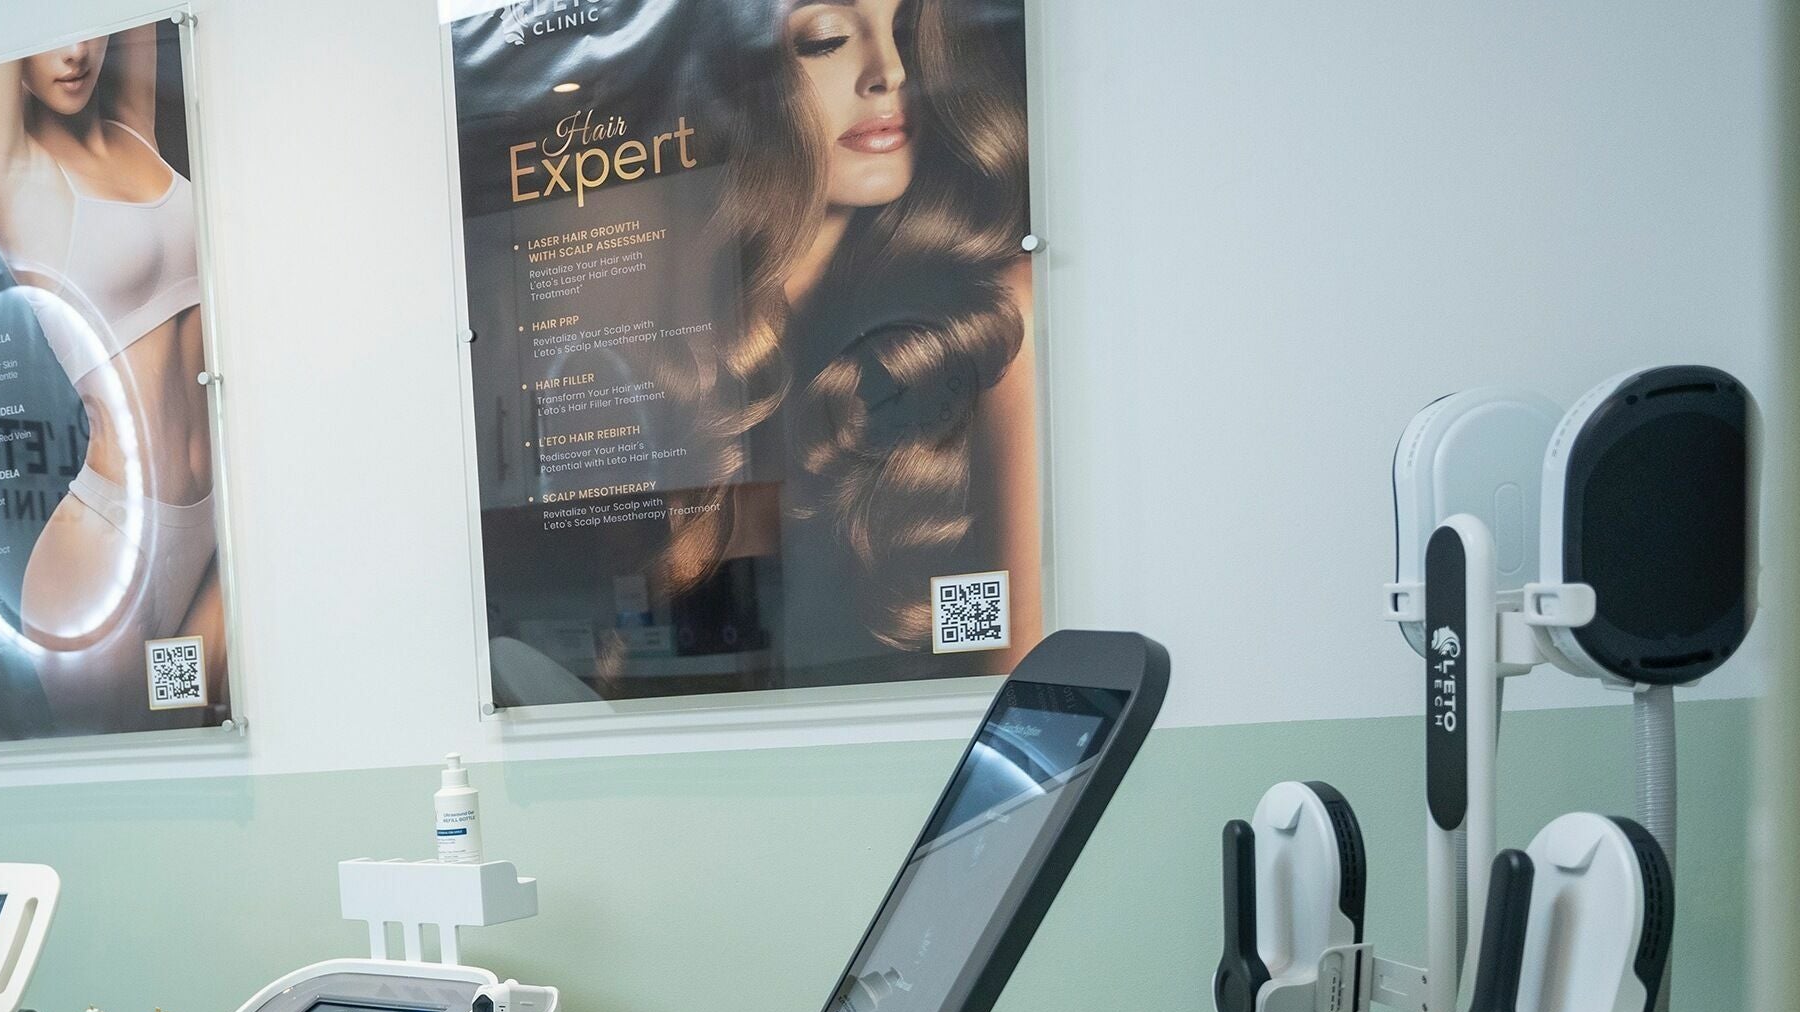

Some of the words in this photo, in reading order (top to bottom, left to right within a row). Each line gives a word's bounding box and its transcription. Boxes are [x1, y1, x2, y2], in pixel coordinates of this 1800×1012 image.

[533, 8, 598, 35] CLINIC
[542, 109, 627, 157] Hair
[510, 116, 697, 208] Expert
[528, 236, 559, 250] LASER
[563, 230, 587, 243] HAIR
[590, 220, 640, 237] GROWTH
[528, 250, 556, 263] WITH
[559, 243, 593, 258] SCALP
[596, 229, 666, 251] ASSESSMENT
[530, 263, 573, 279] Revitalize
[576, 260, 597, 270] Your
[600, 256, 619, 266] Hair
[622, 251, 642, 261] with
[561, 273, 586, 285] Laser
[589, 270, 608, 280] Hair
[611, 262, 646, 275] Growth
[532, 319, 556, 331] HAIR
[560, 315, 579, 327] PRP
[534, 333, 577, 346] Revitalize
[580, 330, 601, 340] Your
[604, 324, 631, 336] Scalp
[633, 320, 654, 330] with
[565, 342, 591, 353] Scalp
[594, 333, 657, 350] Mesotherapy
[659, 322, 712, 337] Treatment
[536, 379, 560, 390] HAIR
[563, 373, 594, 386] FILLER
[537, 392, 585, 405] Transform
[588, 388, 609, 398] Your
[612, 383, 631, 394] Hair
[634, 380, 654, 390] with
[569, 401, 587, 412] Hair
[590, 397, 611, 409] Filler
[614, 391, 665, 406] Treatment
[539, 436, 566, 448] L'ETO
[570, 431, 594, 443] HAIR
[598, 425, 640, 439] REBIRTH
[540, 450, 591, 462] Rediscover
[594, 446, 616, 456] Your
[618, 442, 644, 452] Hair's
[541, 461, 582, 474] Potential
[584, 458, 604, 468] with
[607, 455, 627, 466] Leto
[630, 451, 648, 462] Hair
[652, 447, 687, 460] Rebirth
[542, 490, 576, 504] SCALP
[579, 481, 656, 499] MESOTHERAPY
[544, 506, 587, 519] Revitalize
[589, 504, 611, 514] Your
[613, 500, 640, 512] Scalp
[643, 498, 663, 507] with
[574, 516, 601, 528] Scalp
[603, 509, 666, 524] Mesotherapy
[668, 502, 720, 516] Treatment
[1434, 662, 1442, 726] TECH
[1443, 660, 1456, 732] L'ETO
